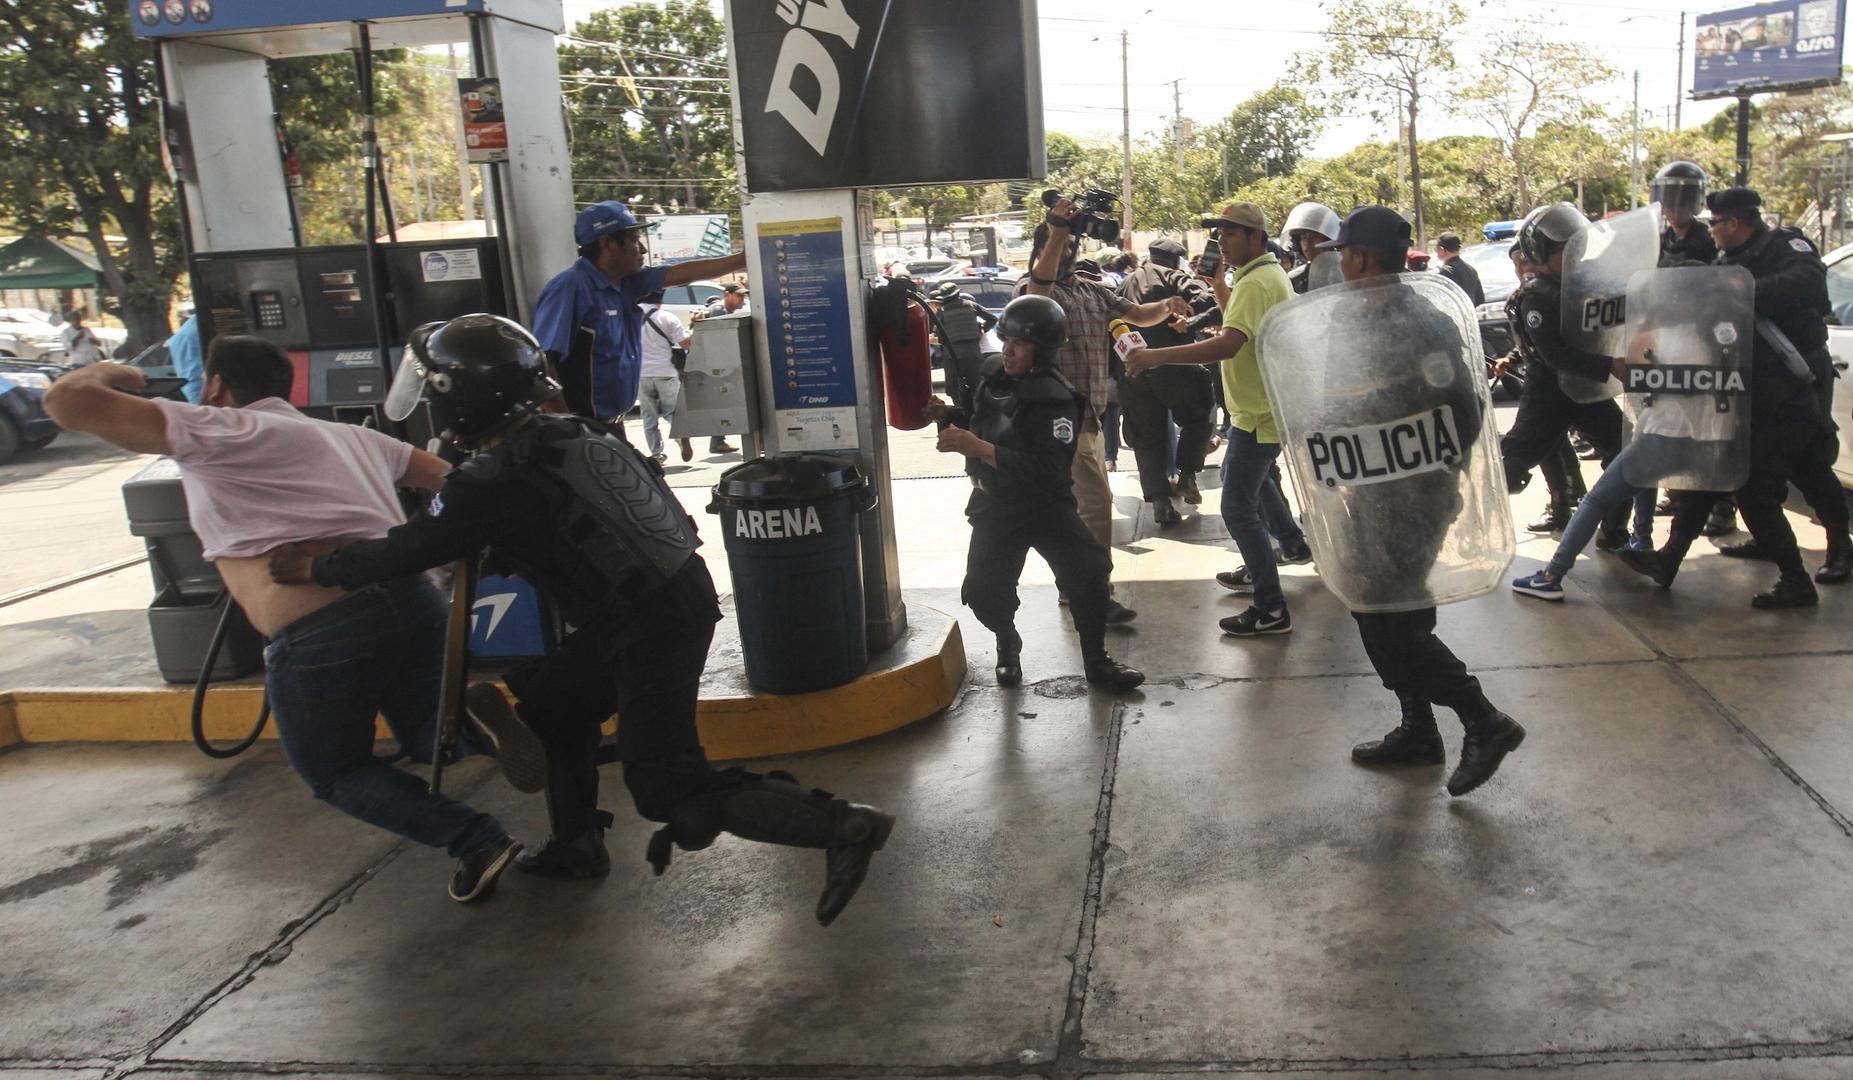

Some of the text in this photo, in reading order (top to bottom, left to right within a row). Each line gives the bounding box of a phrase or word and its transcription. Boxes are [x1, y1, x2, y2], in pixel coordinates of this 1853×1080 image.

[1117, 340, 1128, 354] 12
[1127, 333, 1142, 345] 12
[335, 351, 374, 361] DIESEL
[1630, 368, 1745, 391] POLICIA
[1307, 410, 1457, 481] POLICIA
[735, 506, 823, 539] ARENA
